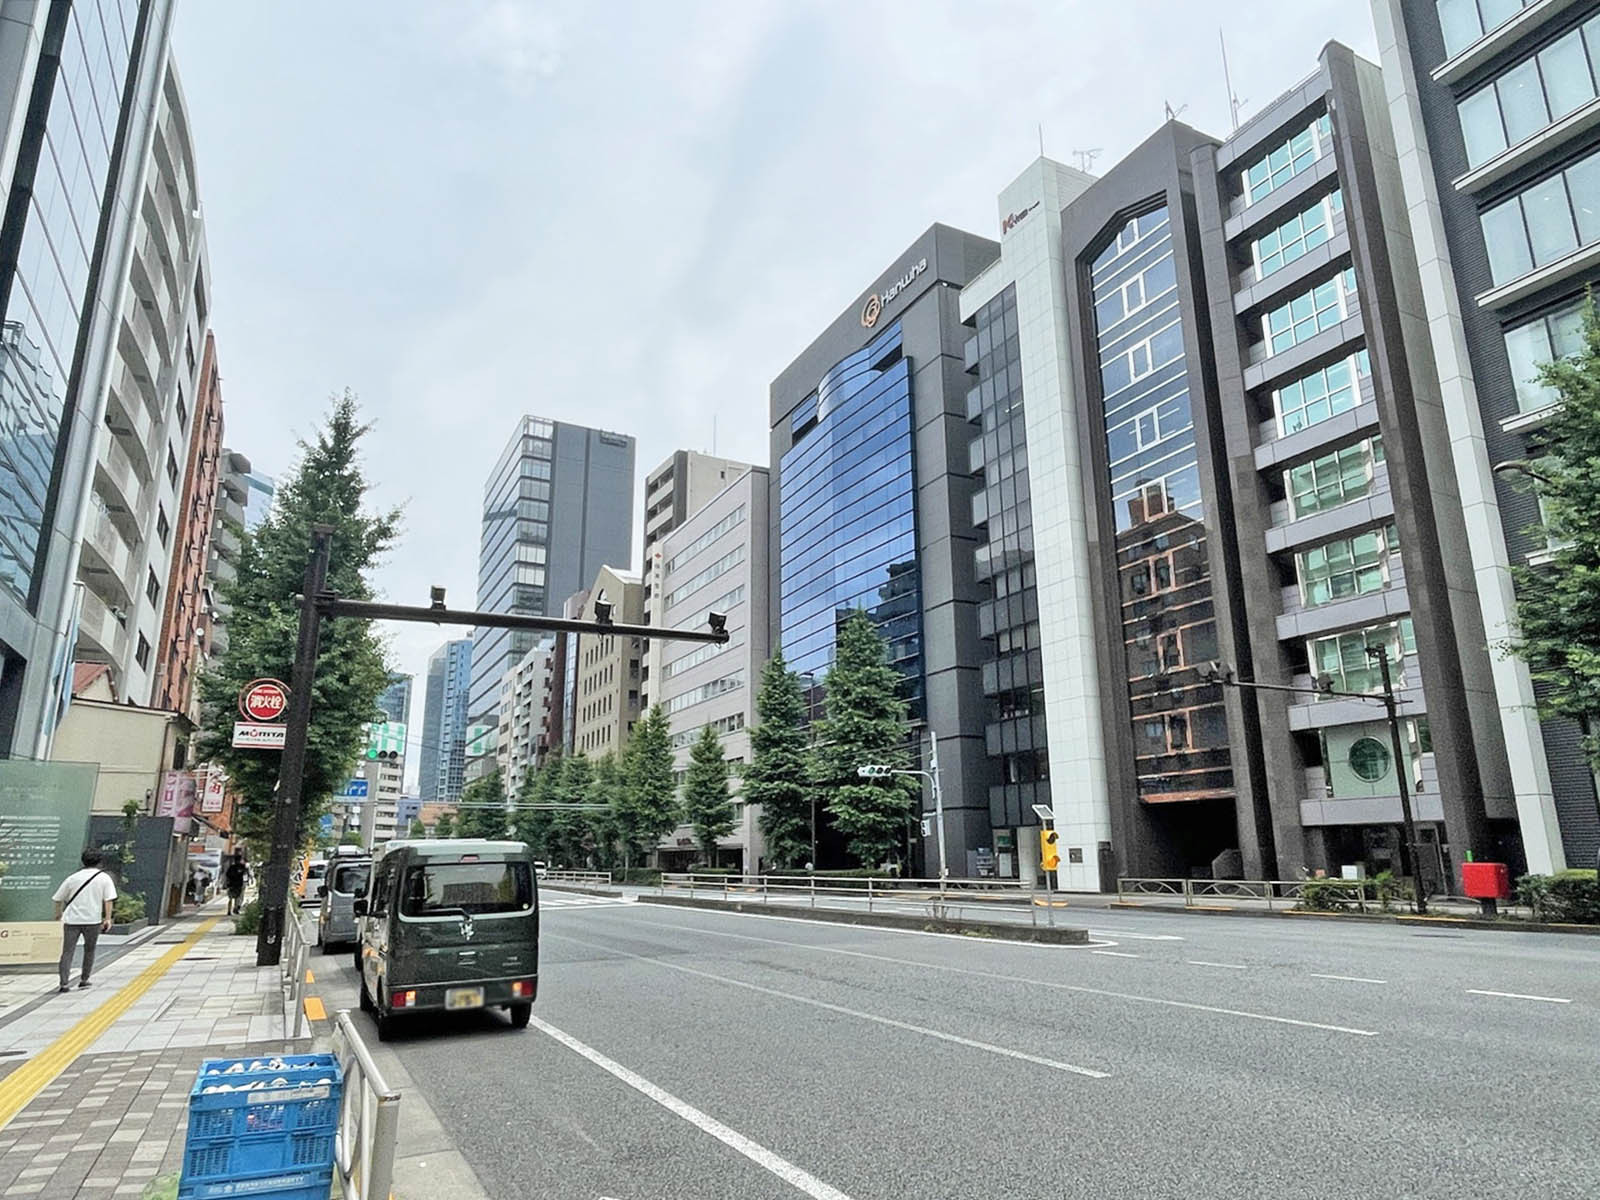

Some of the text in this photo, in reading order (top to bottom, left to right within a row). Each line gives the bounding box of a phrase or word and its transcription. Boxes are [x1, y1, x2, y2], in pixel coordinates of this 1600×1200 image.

[881, 258, 927, 307] Hanwha
[250, 694, 282, 709] 消火栓
